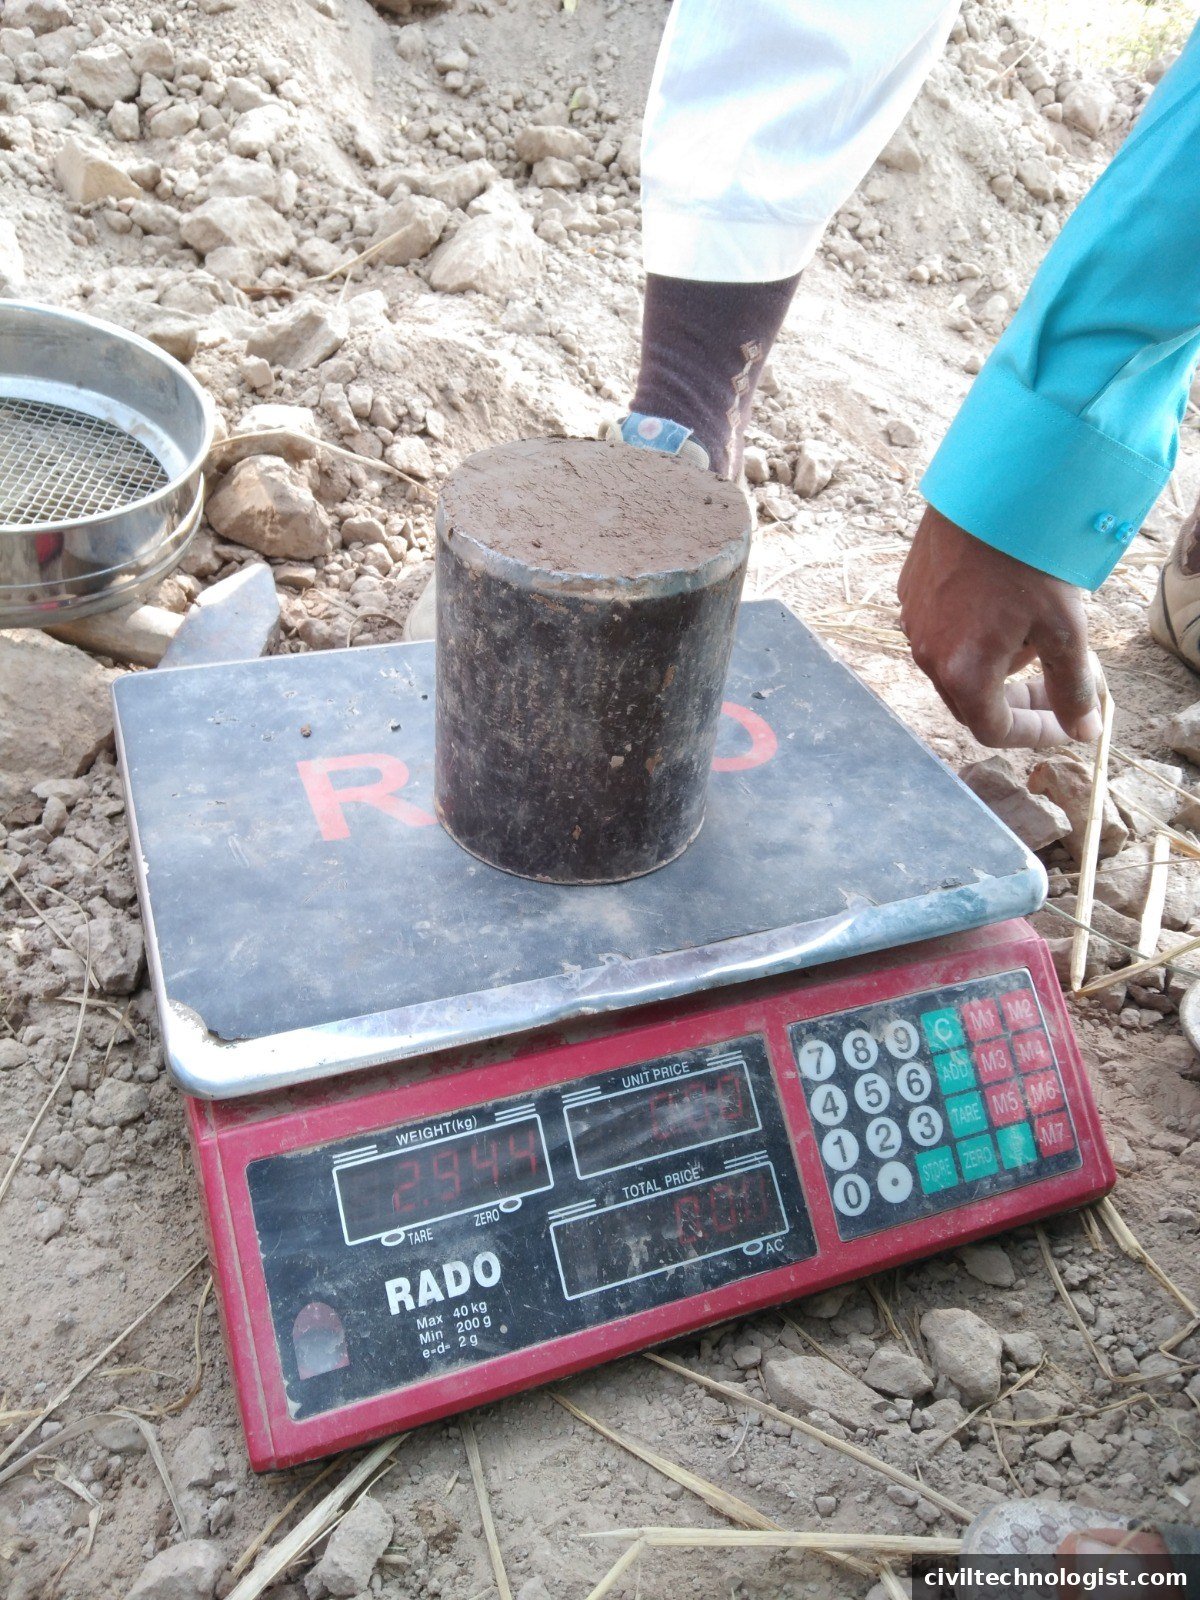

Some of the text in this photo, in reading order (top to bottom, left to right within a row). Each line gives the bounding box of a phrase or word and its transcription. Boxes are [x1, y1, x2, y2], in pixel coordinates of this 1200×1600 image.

[1007, 999, 1033, 1020] M2
[893, 1026, 912, 1054] 9
[934, 1018, 953, 1041] C
[806, 1046, 825, 1075] 7
[852, 1036, 870, 1065] 8
[981, 1050, 1007, 1073] M3
[1019, 1040, 1047, 1062] M4
[622, 1061, 691, 1089] UNIT PRICE
[906, 1068, 924, 1096] 6
[821, 1091, 840, 1118] 4
[863, 1080, 882, 1108] 5
[991, 1091, 1019, 1116] M5
[1031, 1080, 1057, 1104] M6
[917, 1112, 936, 1140] 3
[951, 1103, 982, 1126] TARE
[396, 1115, 478, 1146] WEIGHT(kg)
[875, 1124, 894, 1152] 2
[1041, 1122, 1065, 1147] M7
[833, 1136, 848, 1163] 1
[963, 1146, 993, 1169] ZERO
[622, 1168, 701, 1199] TOTAL PRICE
[843, 1181, 862, 1210] 0
[474, 1209, 500, 1227] ZERO
[407, 1228, 434, 1246] TARE
[766, 1239, 785, 1255] AC
[384, 1251, 502, 1316] RADO
[416, 1301, 487, 1330] Max 40 kg
[419, 1315, 492, 1345] Min 200 g
[458, 1335, 467, 1348] 2
[469, 1334, 478, 1347] g
